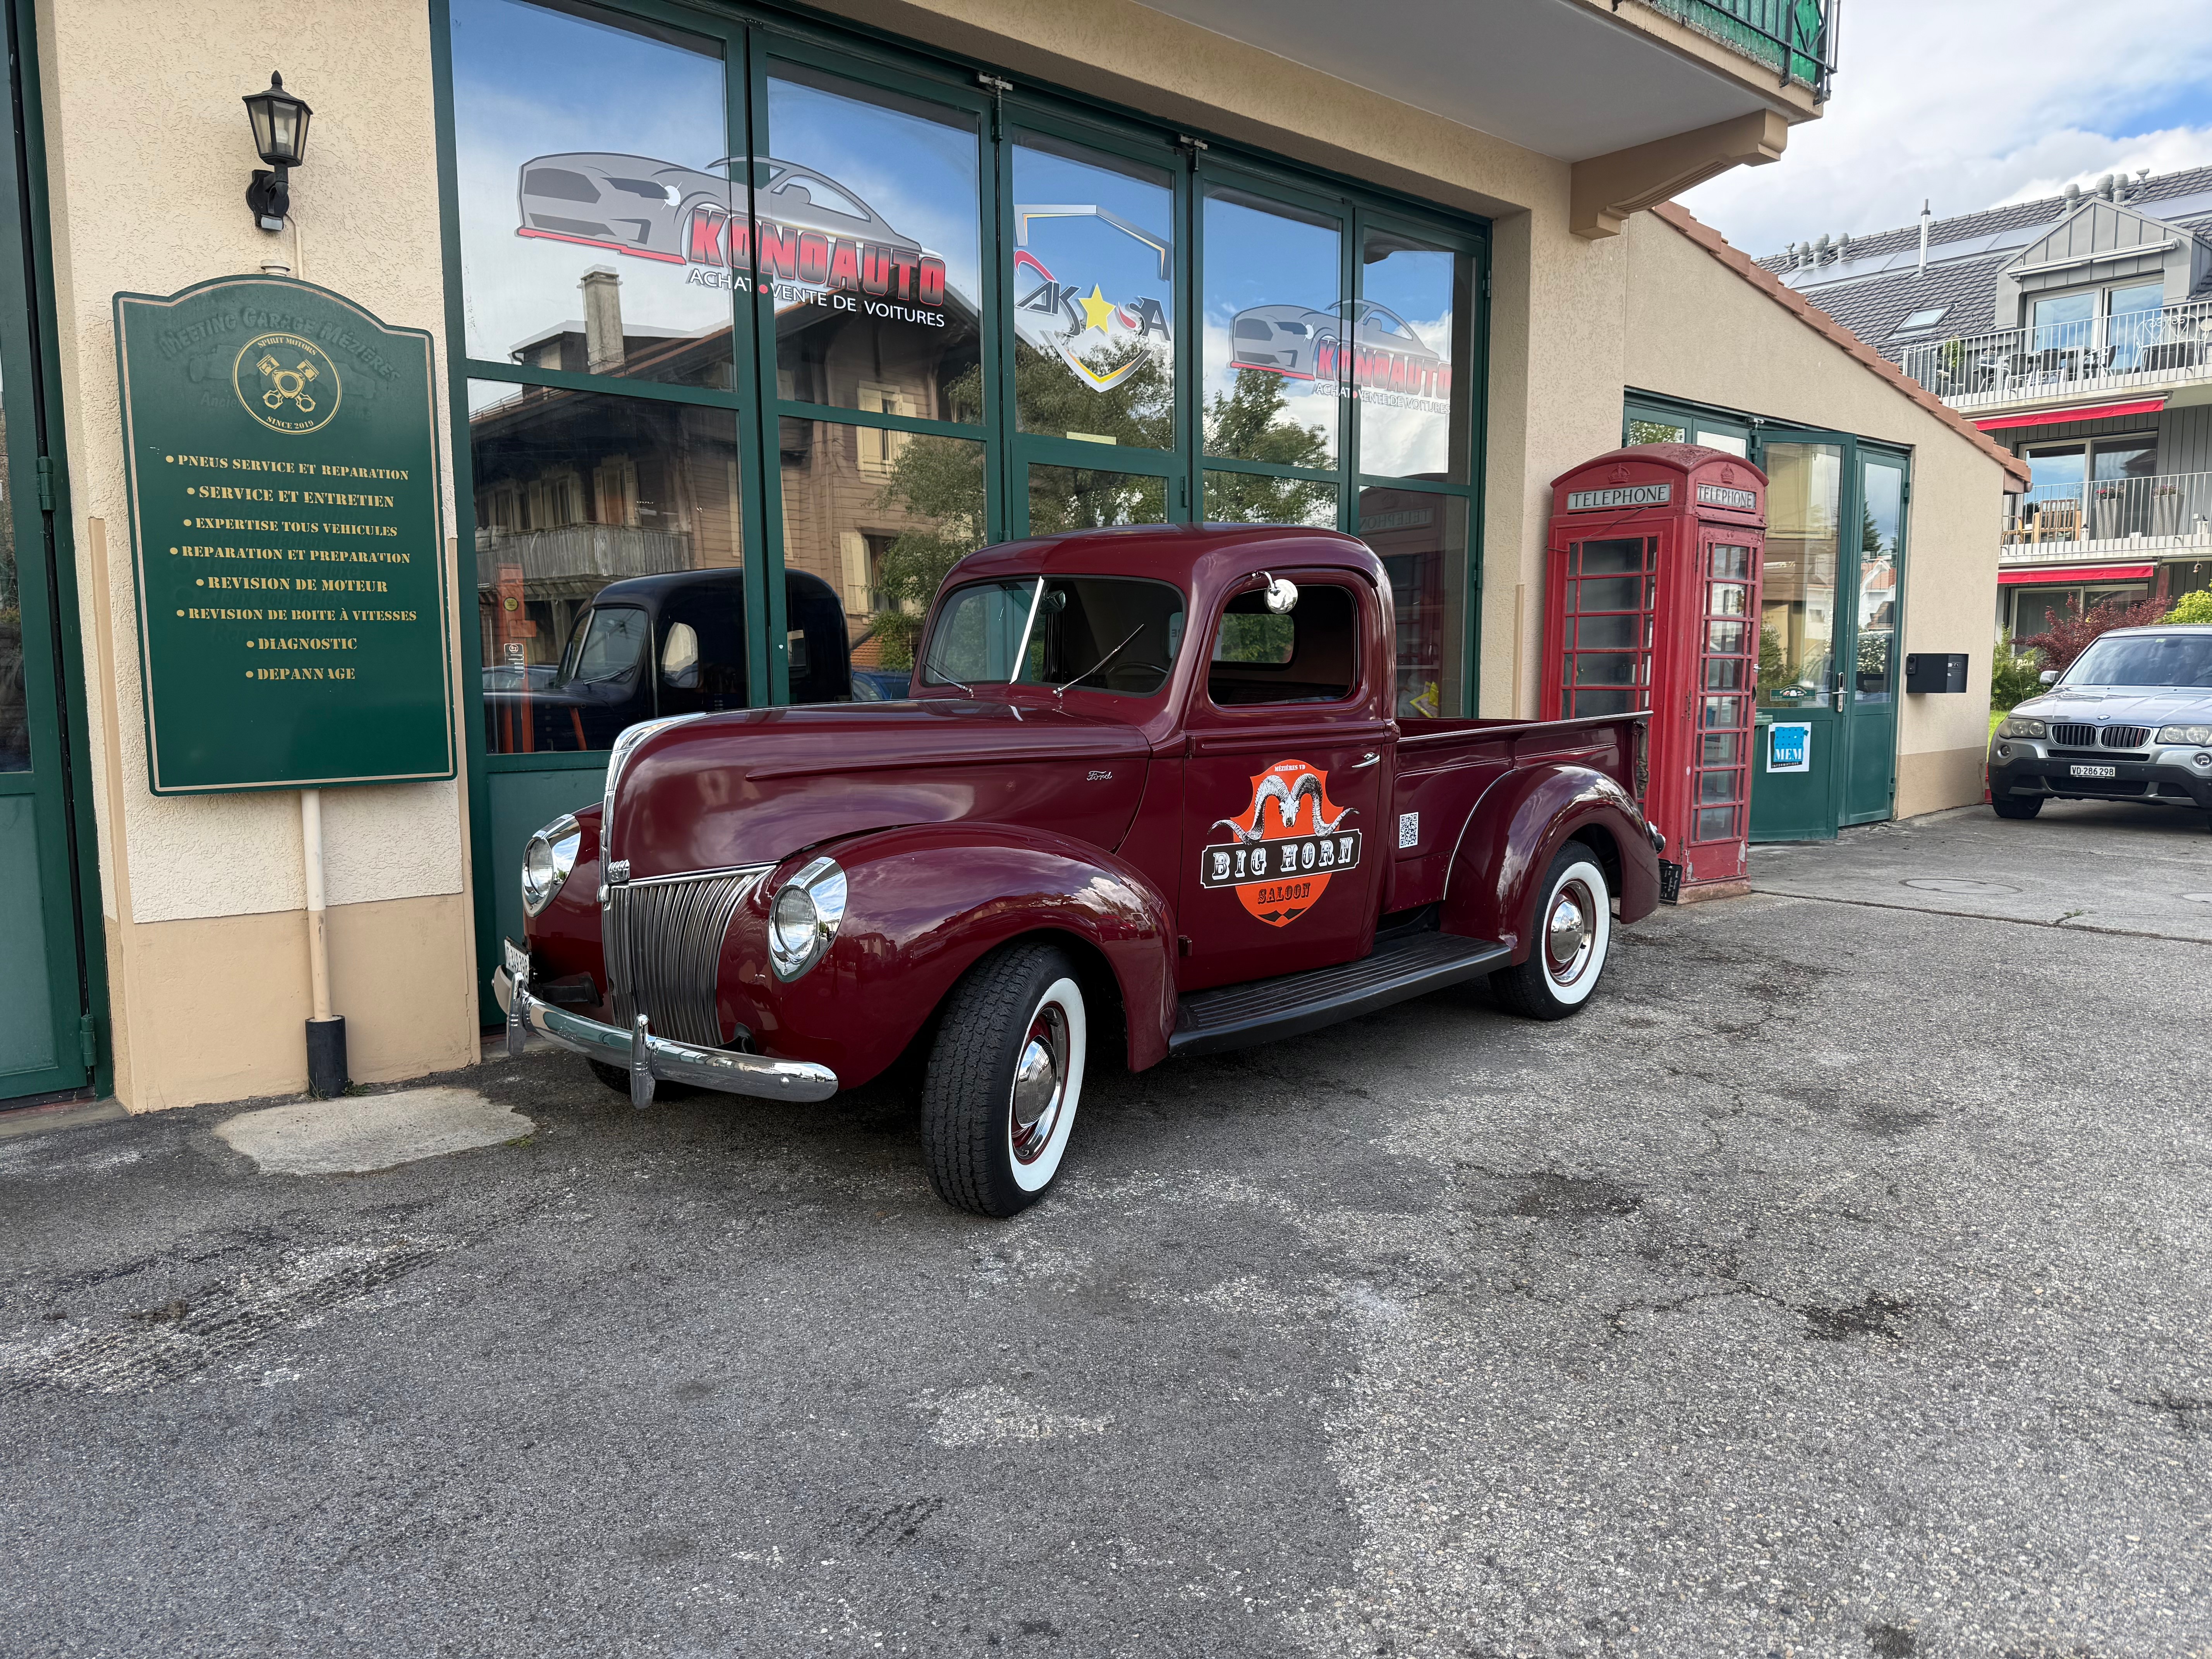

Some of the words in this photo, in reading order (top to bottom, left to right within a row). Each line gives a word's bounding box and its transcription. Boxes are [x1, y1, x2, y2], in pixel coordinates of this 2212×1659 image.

[689, 209, 946, 306] KONOAUTO
[690, 268, 752, 292] ACHAT
[770, 282, 828, 307] VENTE
[833, 295, 857, 312] DE
[864, 300, 945, 328] VOITURES
[258, 337, 284, 348] SPIRIT
[285, 337, 317, 356] MOTORS
[1316, 340, 1452, 400] KONOAUTO
[1316, 383, 1350, 398] ACHAT
[1358, 390, 1388, 405] VENTE
[1390, 395, 1403, 407] DE
[1406, 398, 1450, 414] VOITURES
[266, 416, 292, 429] SINCE
[294, 420, 314, 429] 2019
[178, 455, 228, 469] PNEUS
[232, 459, 295, 474] SERVICE
[299, 464, 316, 474] ET
[322, 465, 409, 480] REPARATION
[199, 486, 273, 502] SERVICE
[278, 490, 298, 503] ET
[304, 491, 394, 507] ENTRETIEN
[1572, 486, 1667, 507] TELEPHONE
[1698, 486, 1752, 507] TELEPHONE
[196, 518, 278, 532] EXPERTISE
[282, 522, 319, 533] TOUS
[323, 524, 398, 536] VEHICULES
[182, 546, 283, 560] REPARATION
[288, 550, 306, 560] ET
[310, 550, 410, 563] PREPARATION
[208, 577, 290, 590] REVISION
[296, 579, 317, 591] DE
[321, 580, 388, 592] MOTEUR
[189, 608, 263, 620] REVISION
[268, 610, 287, 620] DE
[292, 610, 335, 620] BOITE
[339, 608, 349, 621] À
[352, 611, 417, 621] VITESSES
[258, 638, 357, 650] DIAGNOSTIC
[258, 668, 356, 680] DEPANNAGE
[1774, 748, 1802, 760] MEM
[1086, 771, 1112, 781] Ford
[1212, 847, 1267, 880] BIG
[1280, 836, 1354, 872] HORN
[1257, 882, 1311, 905] SALOON
